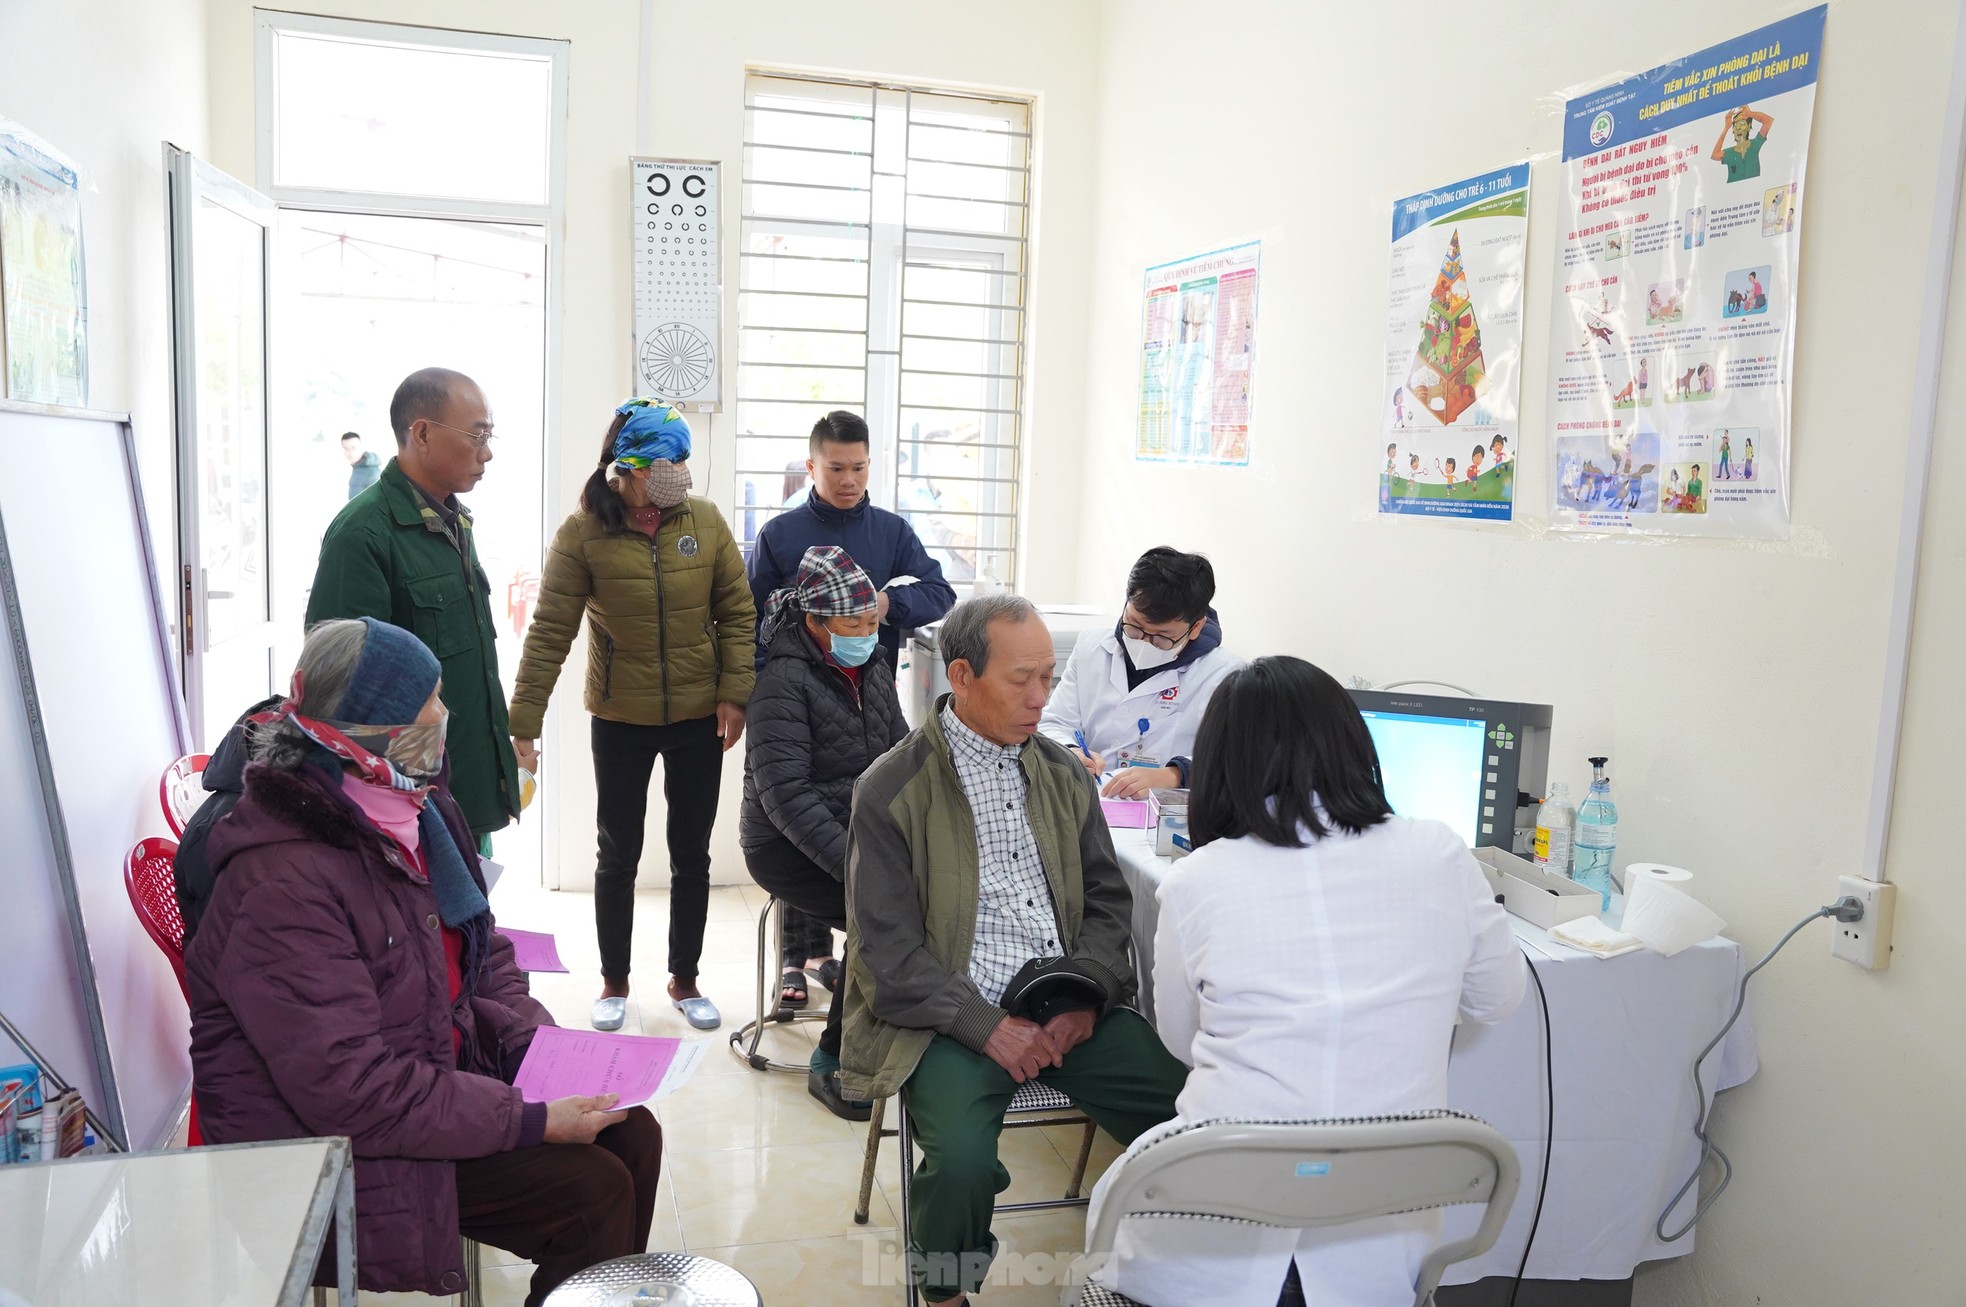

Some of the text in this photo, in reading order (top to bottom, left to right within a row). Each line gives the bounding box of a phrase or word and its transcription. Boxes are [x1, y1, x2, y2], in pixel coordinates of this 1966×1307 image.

[1663, 79, 1683, 95] TIÊM
[1685, 70, 1701, 88] VẮC
[1702, 65, 1718, 82] XIN
[1719, 56, 1750, 76] PHÒNG
[1769, 41, 1781, 59] LÀ
[1639, 104, 1659, 121] CÁCH
[1660, 98, 1676, 113] DUY
[1677, 86, 1698, 108] NHẤT
[1713, 75, 1739, 96] THOÁT
[1741, 65, 1763, 87] KHỎI
[1764, 59, 1790, 79] BỆNH
[1592, 130, 1604, 140] CDC
[1629, 140, 1648, 155] NGUY
[1652, 167, 1670, 181] vong
[1406, 203, 1423, 215] THÁP
[1455, 190, 1468, 202] CHO
[1468, 184, 1480, 198] TRẺ
[1489, 180, 1496, 192] 11
[1497, 173, 1512, 188] TUỔI
